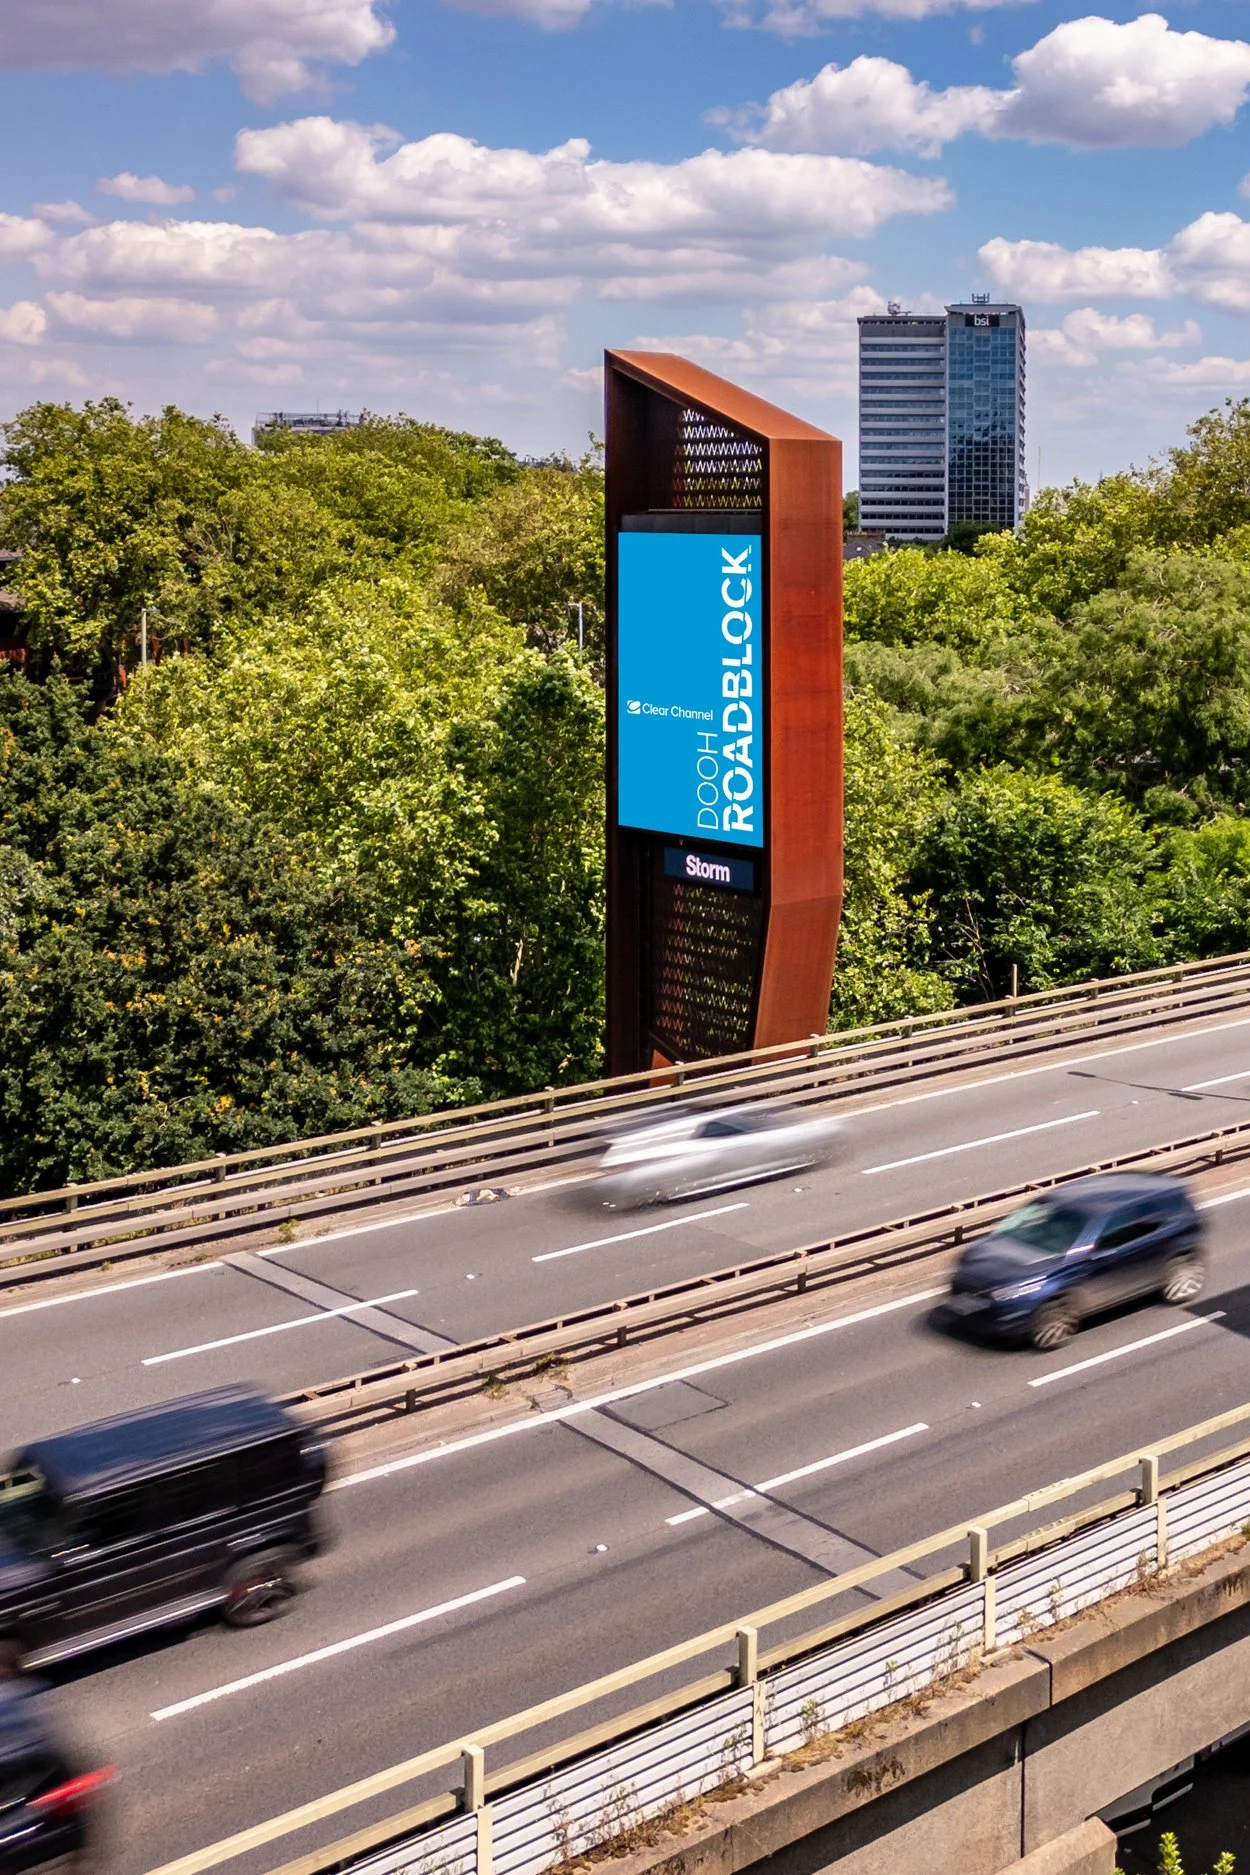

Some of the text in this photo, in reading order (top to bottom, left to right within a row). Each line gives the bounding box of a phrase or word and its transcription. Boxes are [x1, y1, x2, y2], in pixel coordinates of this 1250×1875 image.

[974, 315, 990, 326] bsi
[721, 544, 754, 832] ROADBLOCK
[641, 702, 713, 721] Clear Channel
[697, 731, 719, 830] DOOH
[686, 855, 730, 882] Storm
